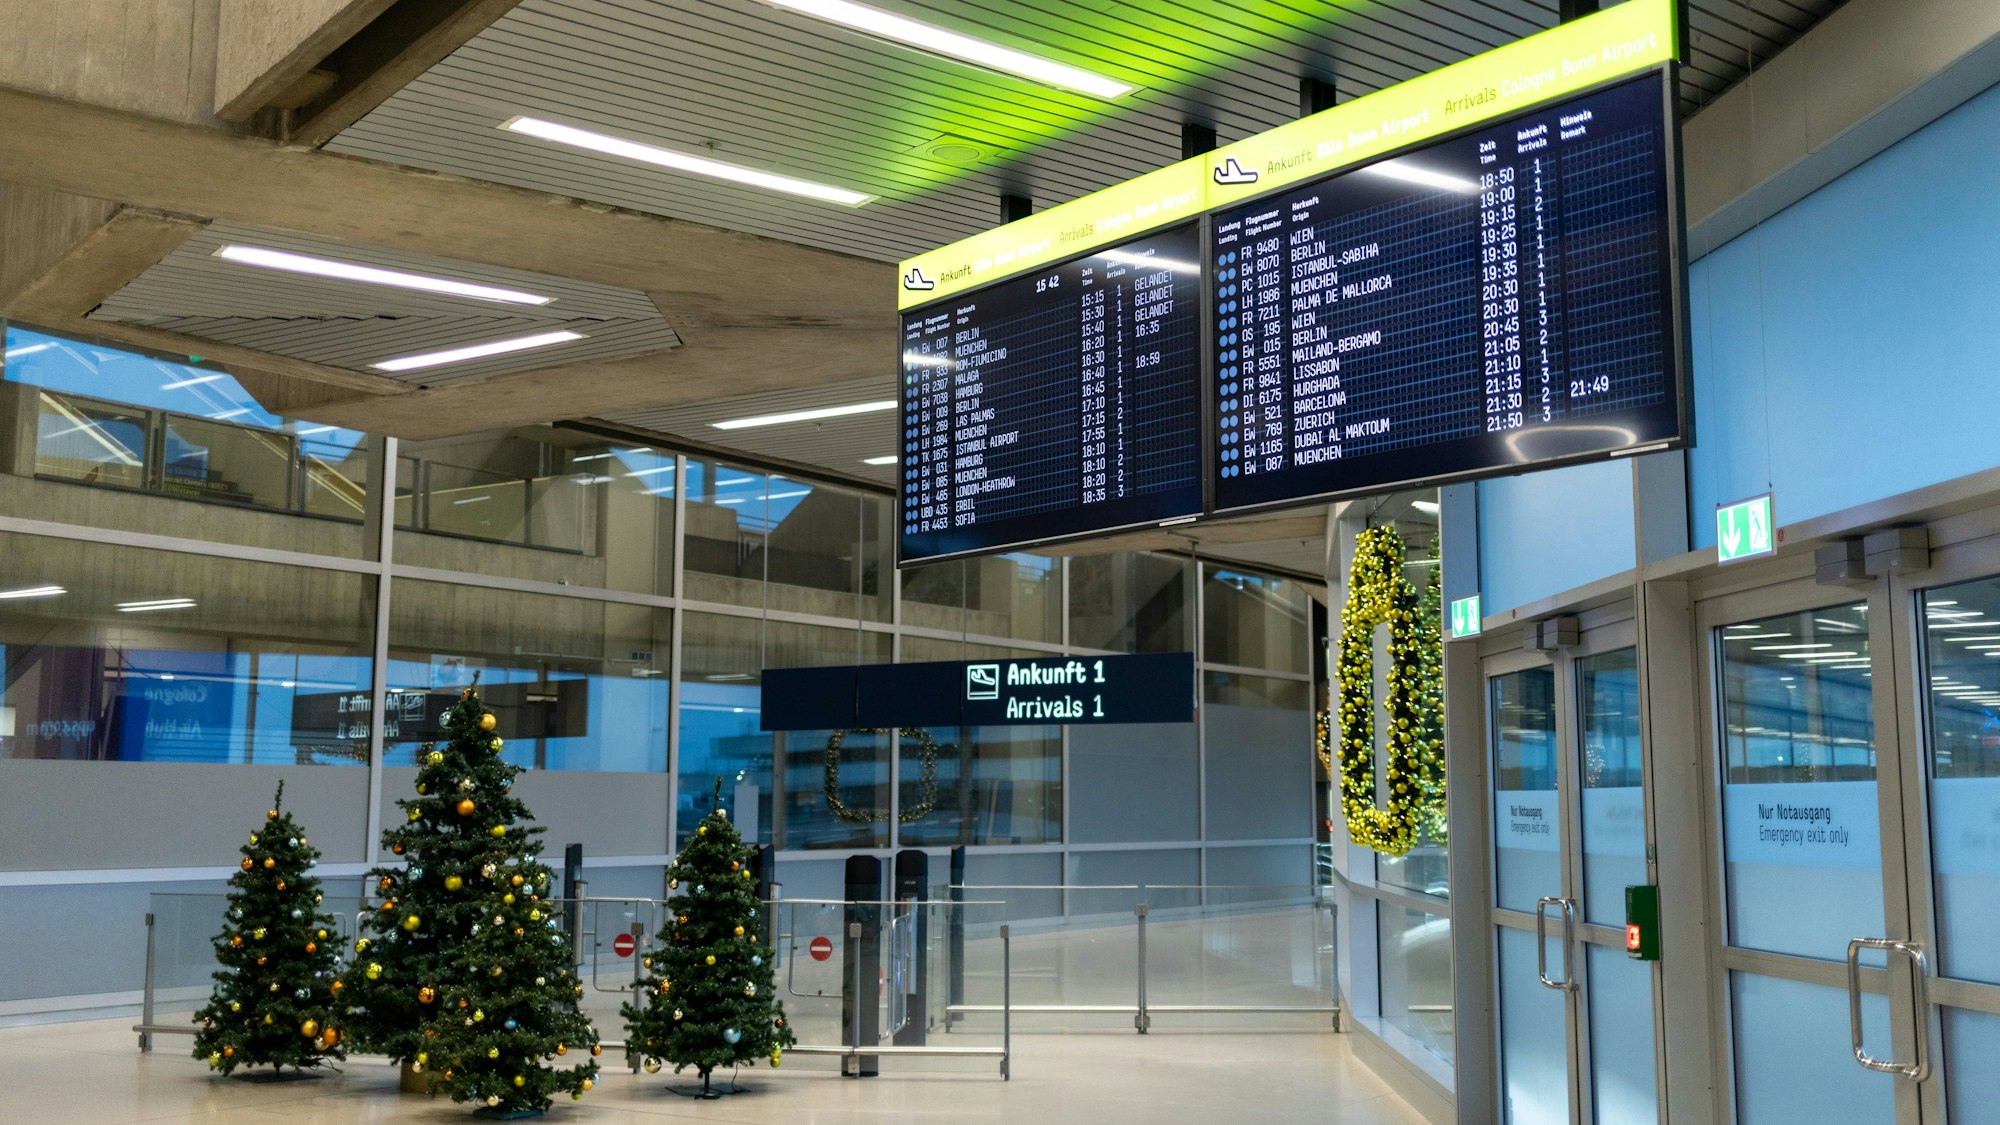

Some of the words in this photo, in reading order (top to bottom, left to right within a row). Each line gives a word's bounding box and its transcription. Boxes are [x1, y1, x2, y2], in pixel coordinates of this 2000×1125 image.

[1267, 150, 1312, 175] Ankunft
[1381, 108, 1430, 136] Airport
[1444, 88, 1496, 115] Arrivals
[1501, 67, 1556, 96] Cologne
[1562, 54, 1596, 78] Bonn
[1602, 32, 1657, 64] Airport
[1218, 219, 1240, 235] Landung
[1245, 207, 1279, 227] Flugnummer
[1291, 194, 1319, 211] Herkunft
[1479, 138, 1496, 153] Zeit
[1517, 122, 1547, 141] Ankunft
[1559, 107, 1591, 128] Hinweis
[1218, 232, 1237, 246] Landing
[1245, 224, 1261, 237] Flight
[1262, 218, 1282, 231] Number
[1292, 210, 1309, 223] Origin
[1480, 152, 1496, 165] Time
[1517, 136, 1547, 154] Arrivals
[1560, 124, 1586, 140] Remark
[1241, 245, 1251, 259] FR
[1257, 237, 1278, 255] 9480
[1290, 226, 1313, 245] WIEN
[1479, 166, 1514, 191] 18:50
[1241, 261, 1252, 276] EW
[1257, 253, 1279, 272] 8070
[1291, 240, 1325, 262] BERLIN
[1480, 184, 1514, 208] 19:00
[940, 264, 972, 284] Ankunft
[1060, 224, 1094, 245] Arrivals
[1242, 277, 1252, 292] PC
[1258, 270, 1279, 288] 1015
[1292, 242, 1378, 278] ISTANBUL-SABIHA
[1481, 203, 1515, 226] 19:15
[1242, 294, 1252, 308] LH
[1258, 287, 1279, 305] 1986
[1291, 271, 1337, 296] MUENCHEN
[1482, 222, 1515, 245] 19:25
[956, 327, 978, 343] BERLIN
[1082, 289, 1103, 306] 15:15
[1135, 268, 1172, 291] GELANDET
[1036, 278, 1045, 293] 15
[1048, 274, 1059, 289] 42
[1242, 310, 1252, 325] FR
[1259, 304, 1278, 321] 7211
[1292, 292, 1320, 312] PALMA
[1326, 288, 1337, 303] DE
[1343, 273, 1391, 299] MALLORCA
[1482, 240, 1516, 263] 19:30
[1242, 327, 1252, 342] OS
[1264, 320, 1279, 336] 195
[1292, 311, 1315, 329] WIEN
[1483, 259, 1516, 282] 19:35
[954, 347, 1006, 372] ROM-FIUMICINO
[1082, 319, 1104, 336] 15:40
[1135, 300, 1171, 322] GELANDET
[955, 339, 986, 357] MUENCHEN
[1082, 304, 1103, 321] 15:30
[1135, 284, 1171, 306] GELANDET
[955, 369, 978, 385] MALAGA
[1082, 335, 1104, 351] 16:20
[1136, 319, 1159, 337] 16:35
[1243, 343, 1253, 358] EW
[1264, 337, 1280, 353] 015
[1293, 325, 1326, 346] BERLIN
[1482, 278, 1517, 301] 20:30
[1243, 360, 1253, 374] FR
[1259, 354, 1279, 371] 5551
[1292, 330, 1380, 363] MAILAND-BERGAMO
[1483, 297, 1518, 319] 20:30
[956, 382, 982, 399] HAMBURG
[1082, 350, 1104, 366] 16:30
[956, 397, 978, 413] BERLIN
[1082, 365, 1104, 382] 16:40
[1136, 351, 1159, 368] 18:59
[1243, 377, 1253, 390] FR
[1259, 371, 1279, 387] 9841
[1294, 357, 1339, 380] LISSABON
[1484, 316, 1519, 338] 20:45
[1243, 393, 1252, 408] DI
[1259, 387, 1281, 404] 6175
[1293, 374, 1339, 397] HURGHADA
[1484, 335, 1519, 356] 21:05
[955, 423, 986, 441] MUENCHEN
[1082, 395, 1104, 412] 17:10
[956, 414, 967, 427] LAS
[971, 407, 994, 423] PALMAS
[1082, 380, 1104, 397] 16:45
[1244, 410, 1254, 424] EW
[1265, 405, 1280, 420] 521
[1294, 391, 1345, 414] BARCELONA
[1485, 354, 1520, 375] 21:10
[1244, 427, 1255, 441] EW
[1266, 421, 1281, 436] 769
[1294, 411, 1334, 431] ZUERICH
[1486, 373, 1521, 394] 21:15
[1244, 443, 1255, 457] EW
[1260, 438, 1282, 454] 1165
[1295, 430, 1321, 448] DUBAI
[1329, 427, 1339, 442] AL
[1346, 418, 1389, 438] MAKTOUM
[1486, 392, 1521, 413] 21:30
[1570, 376, 1608, 397] 21:49
[955, 453, 982, 469] HAMBURG
[1083, 426, 1104, 442] 17:55
[955, 466, 986, 483] MUENCHEN
[1083, 441, 1104, 457] 18:10
[956, 438, 985, 455] ISTANBUL
[990, 431, 1017, 447] AIRPORT
[1082, 411, 1104, 427] 17:15
[1245, 460, 1255, 474] EW
[1266, 455, 1282, 470] 087
[1294, 444, 1341, 465] MUENCHEN
[1487, 411, 1522, 432] 21:50
[955, 512, 974, 526] SOFIA
[1083, 488, 1105, 503] 18:35
[956, 475, 1014, 497] LONDON-HEATHROW
[1083, 457, 1105, 473] 18:10
[956, 497, 974, 512] ERBIL
[1083, 472, 1105, 488] 18:20
[1006, 696, 1083, 718] Arrivals
[1092, 694, 1104, 717] 1
[1007, 660, 1086, 685] Ankunft
[1094, 660, 1105, 682] 1
[1758, 804, 1774, 820] Nur
[1777, 804, 1830, 824] Notausgang
[1760, 825, 1804, 846] Emergency
[1808, 826, 1826, 843] exit
[1830, 826, 1848, 847] only
